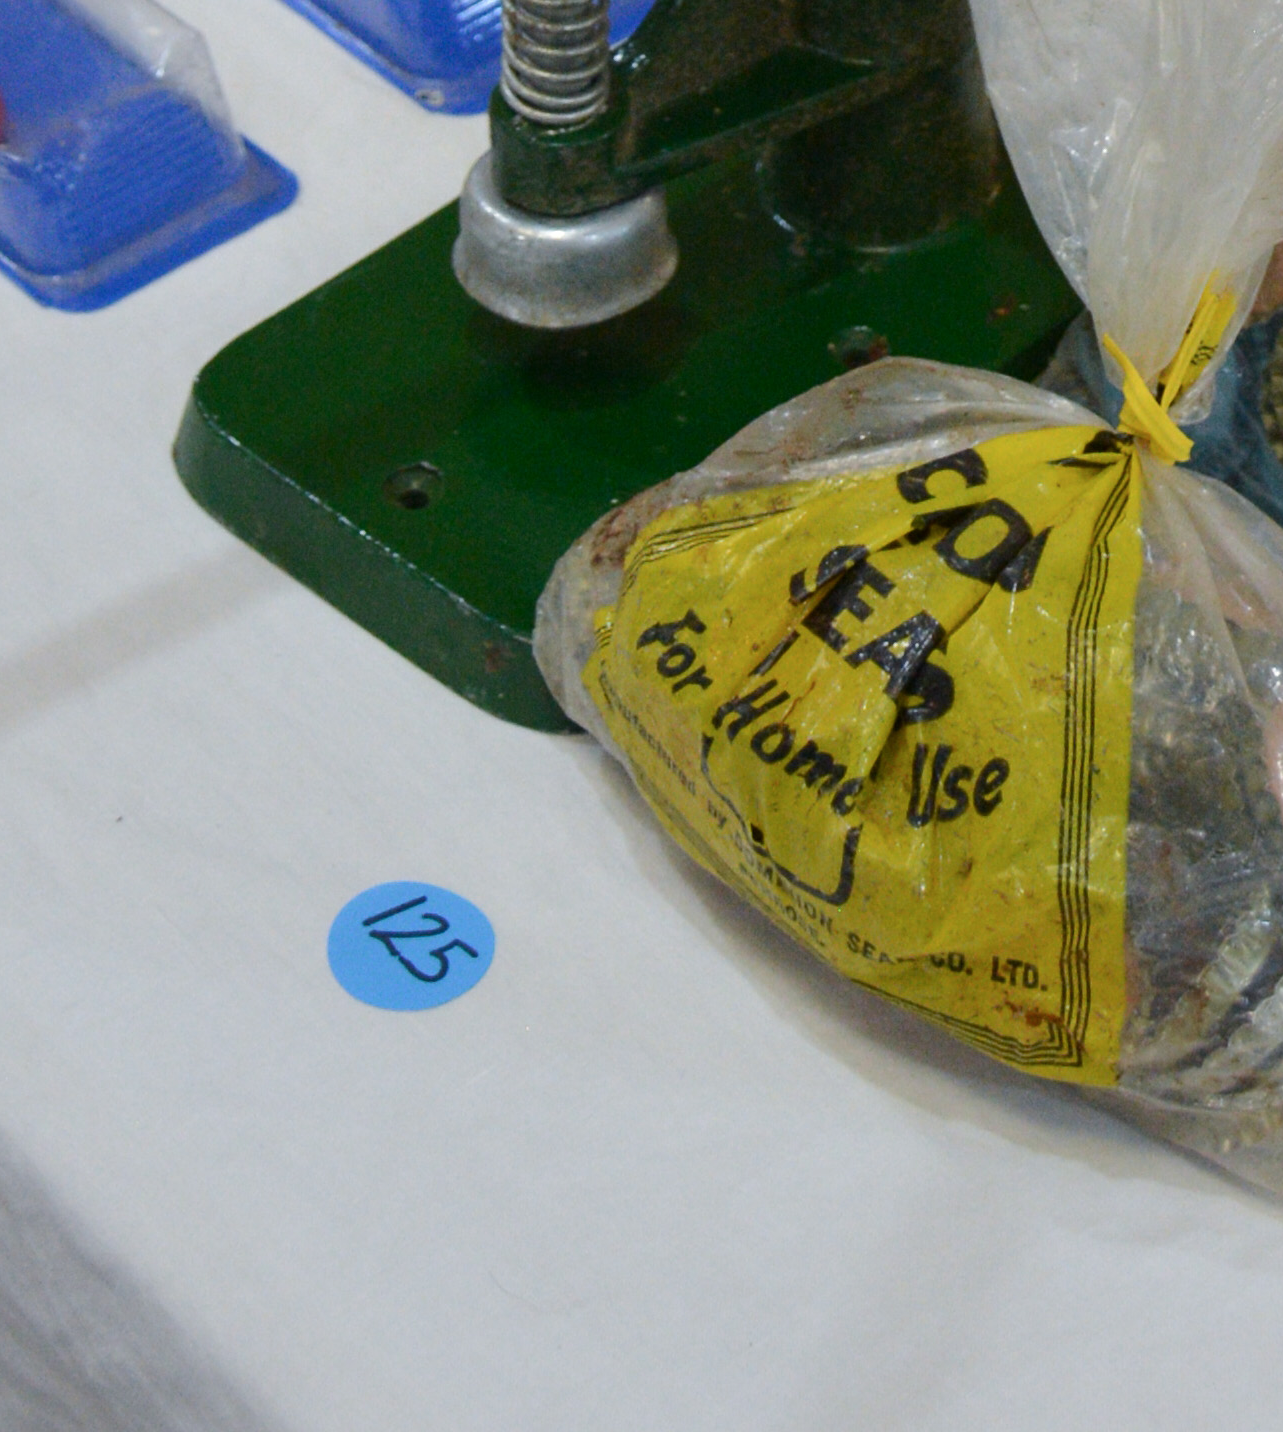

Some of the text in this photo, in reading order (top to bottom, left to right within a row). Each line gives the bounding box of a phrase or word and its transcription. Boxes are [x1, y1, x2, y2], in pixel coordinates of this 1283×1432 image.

[636, 608, 714, 695] For
[906, 742, 1011, 829] Use
[362, 895, 479, 983] 125
[990, 955, 1050, 993] LTD.
